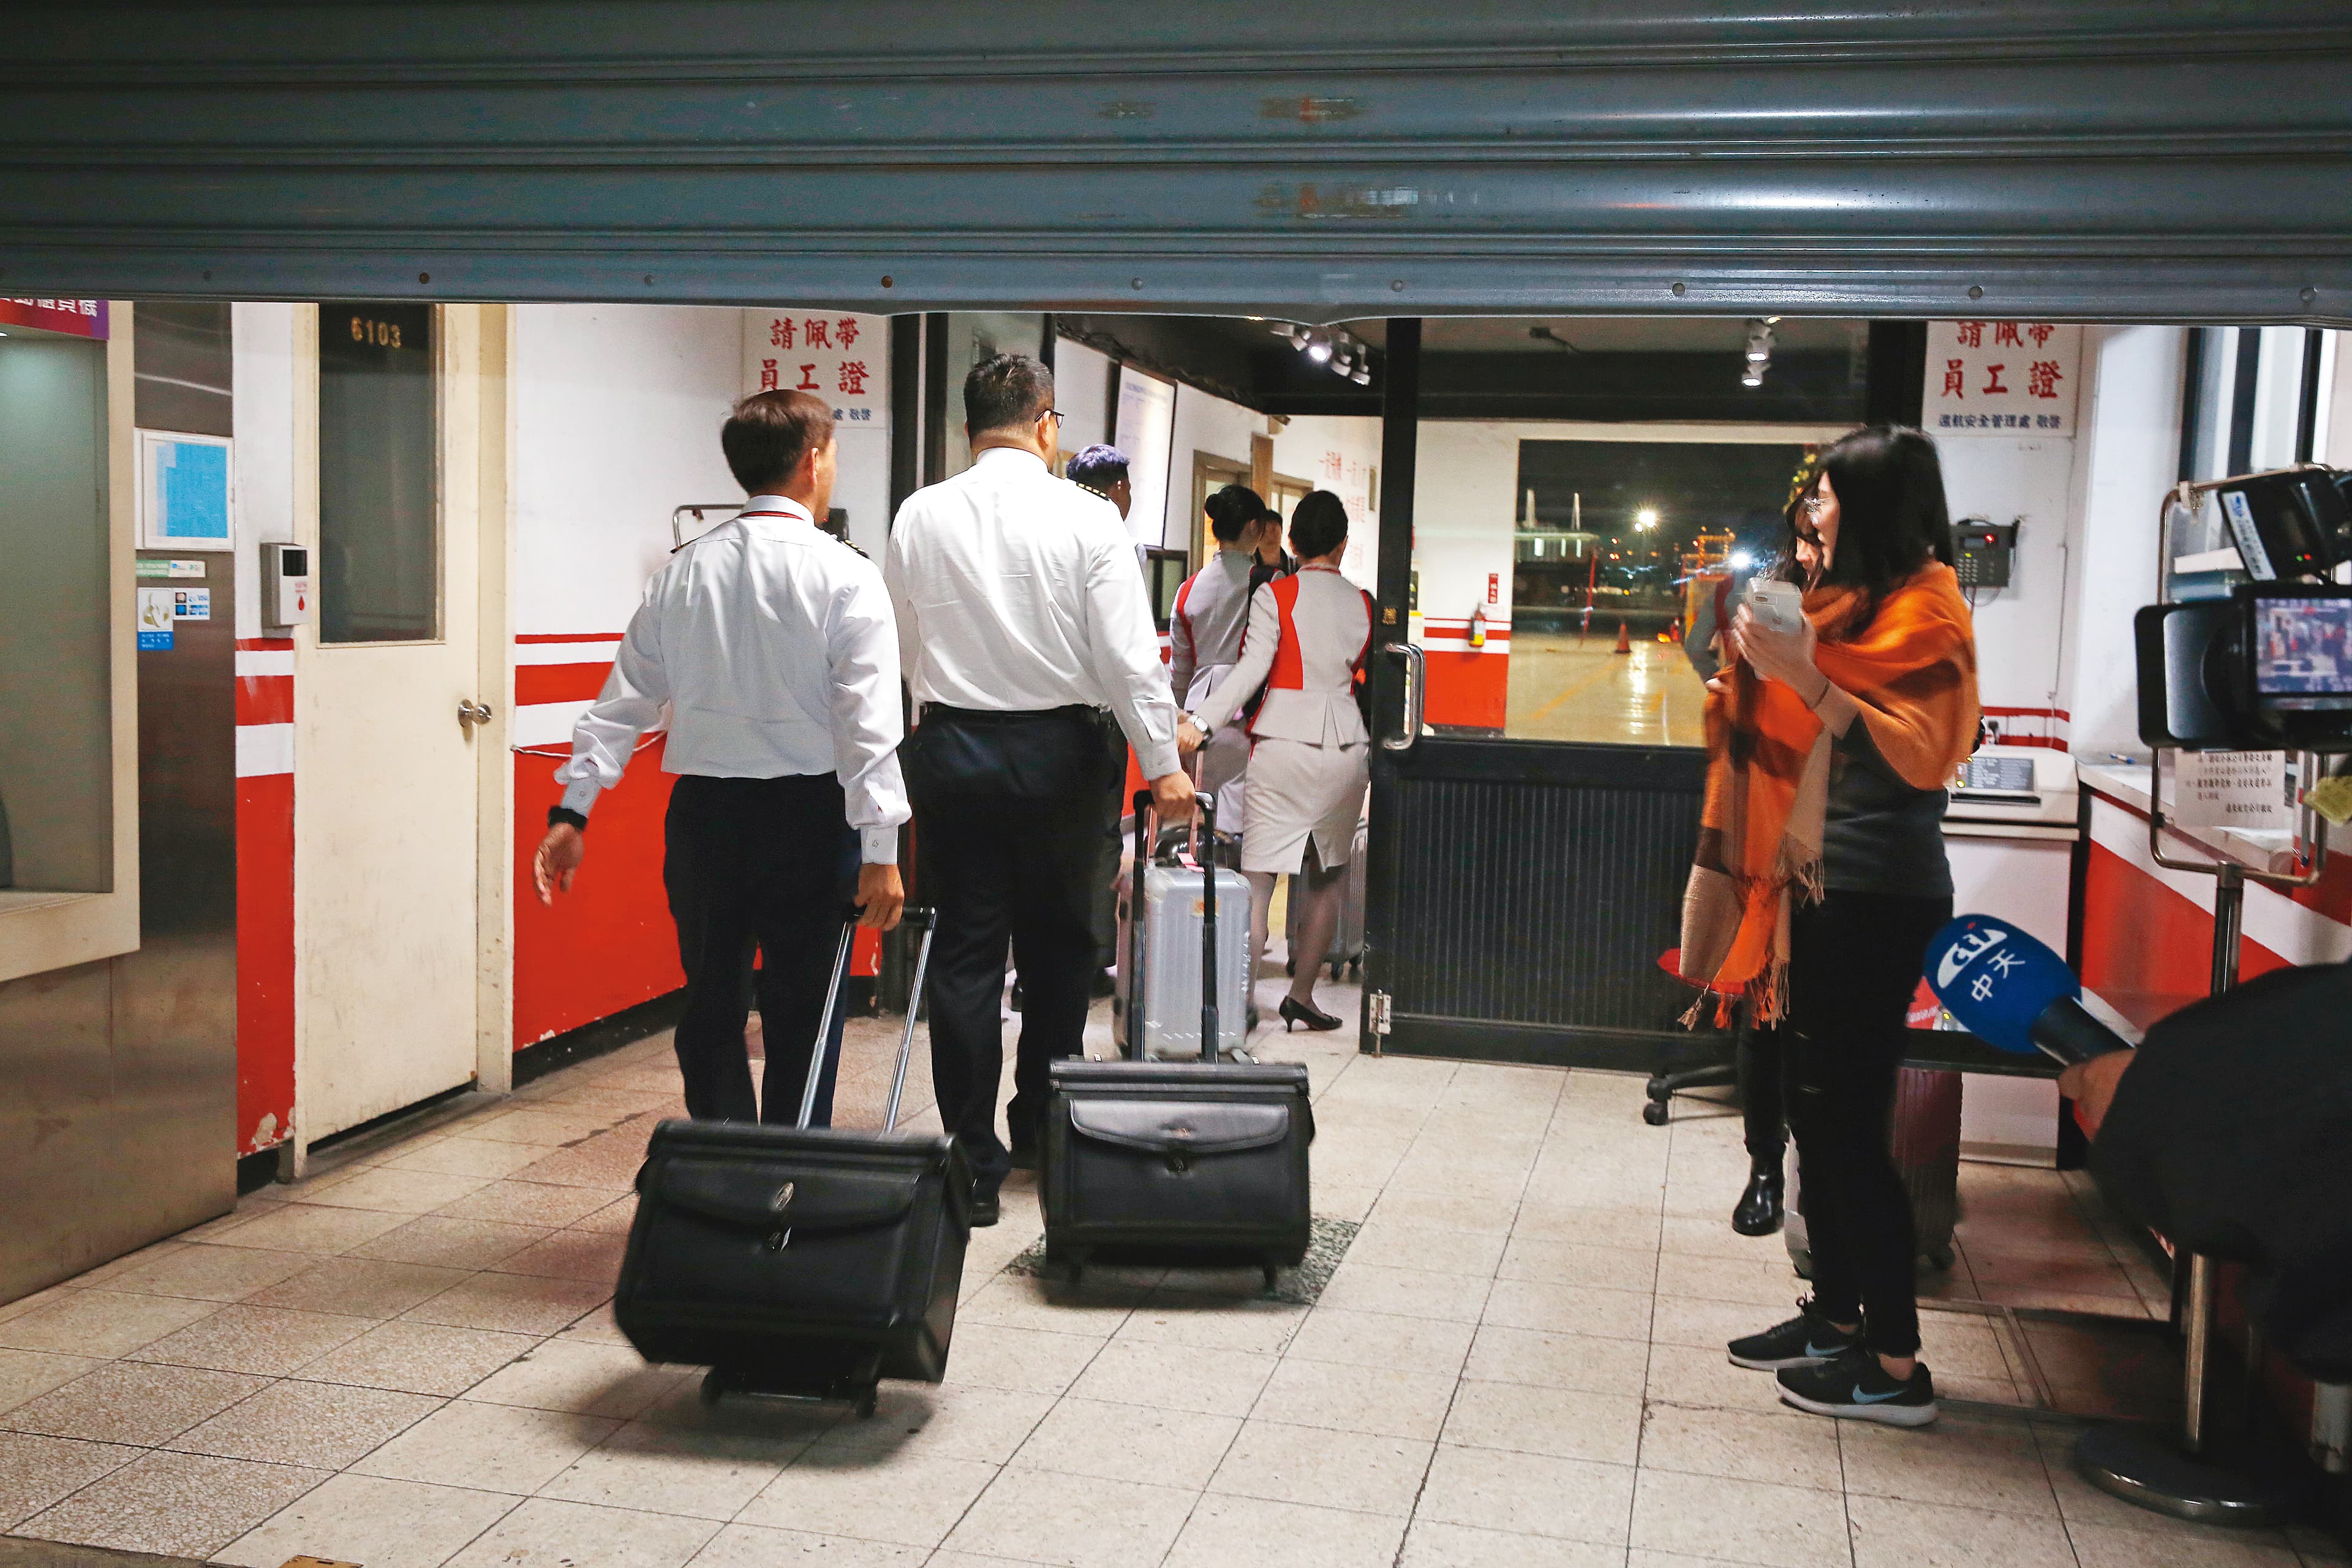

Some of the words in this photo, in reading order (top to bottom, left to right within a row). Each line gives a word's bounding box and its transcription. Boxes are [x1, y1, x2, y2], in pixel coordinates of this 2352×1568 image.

[351, 317, 402, 349] 6103
[770, 317, 859, 350] 請佩帶
[758, 358, 869, 394] 員工證
[1940, 358, 2063, 399] 員工證
[1971, 949, 2026, 1001] 中天
